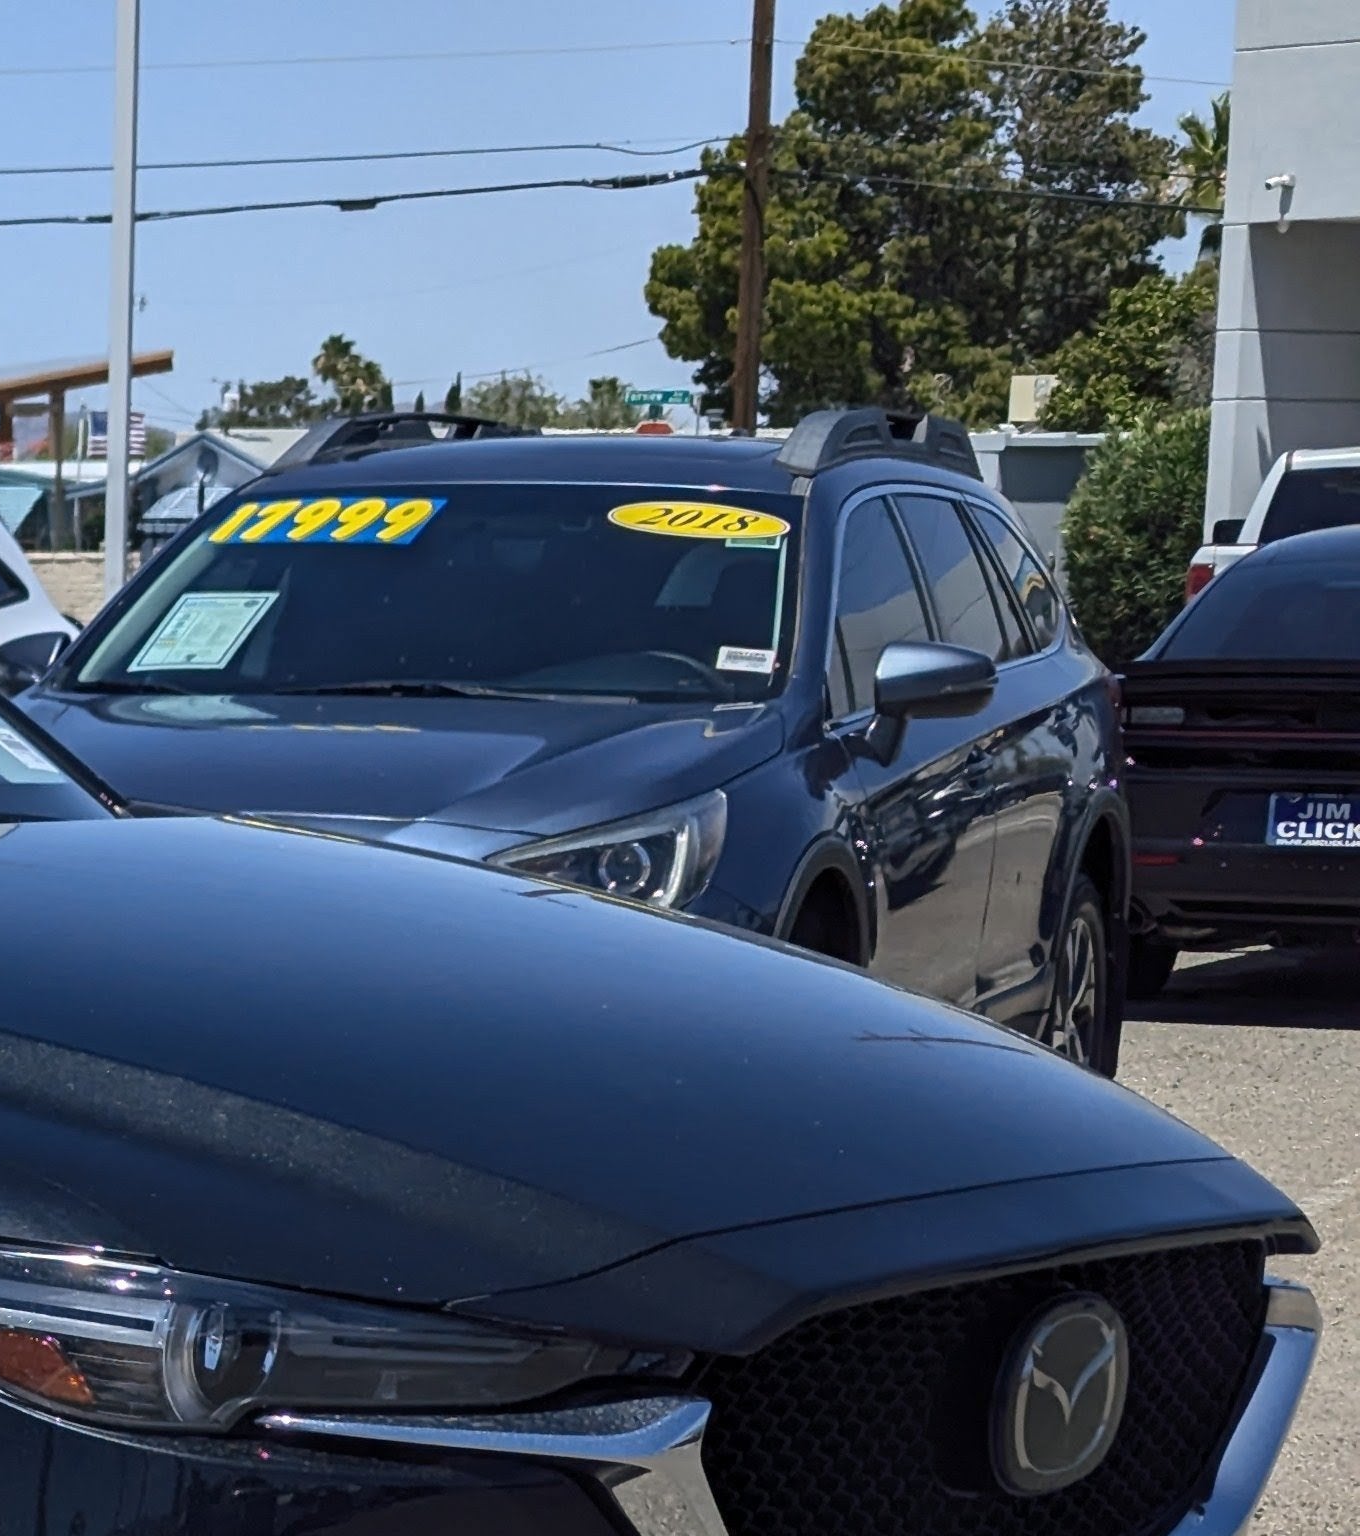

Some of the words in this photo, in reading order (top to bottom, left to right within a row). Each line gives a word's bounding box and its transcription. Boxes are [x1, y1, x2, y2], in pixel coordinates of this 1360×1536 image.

[208, 499, 435, 542] 17999
[636, 507, 761, 532] 2018
[1298, 802, 1351, 820] JIM
[1276, 821, 1360, 839] CLICK
